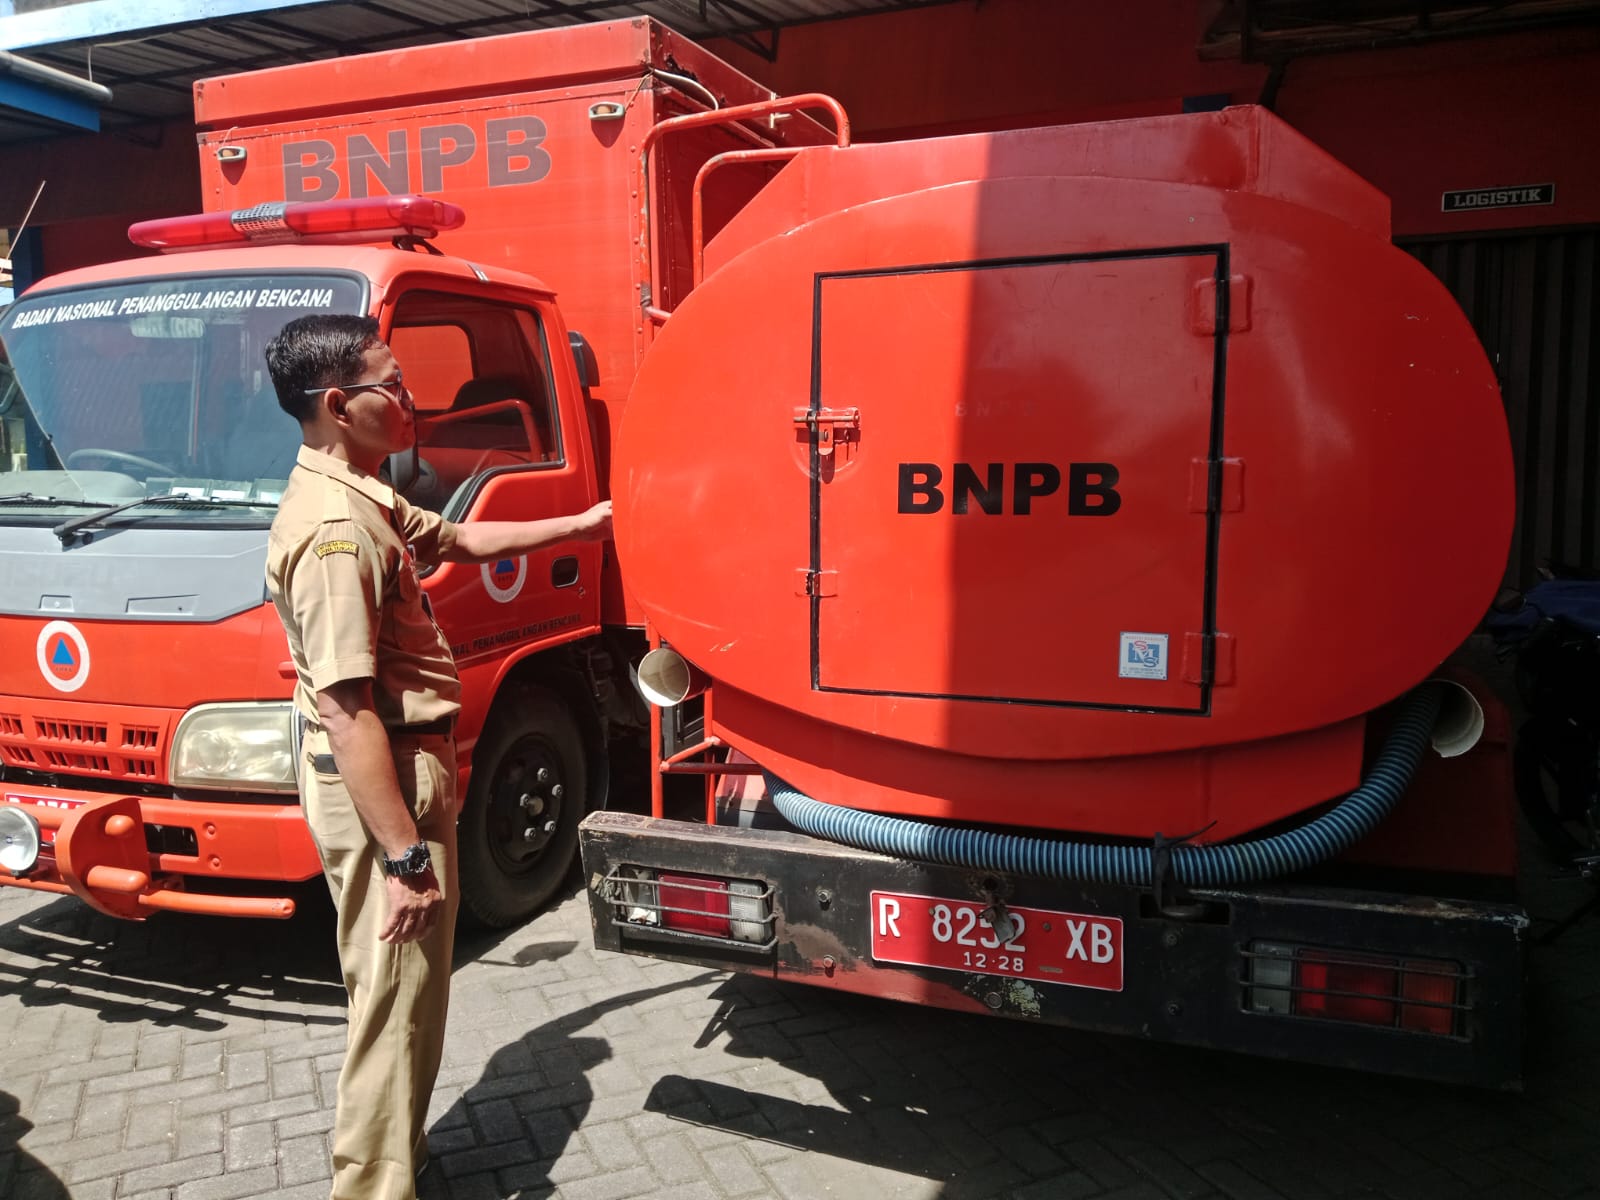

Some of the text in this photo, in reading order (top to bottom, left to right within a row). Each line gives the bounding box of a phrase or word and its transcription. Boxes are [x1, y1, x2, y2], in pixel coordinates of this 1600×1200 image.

[281, 114, 553, 203] BNPB
[1454, 188, 1542, 208] LOGISTIK
[12, 289, 333, 328] BADAN NASIONAL PENANGGULANGAN BENCANA
[897, 462, 1122, 517] BNPB
[878, 897, 901, 938] R
[1064, 919, 1115, 964] XB
